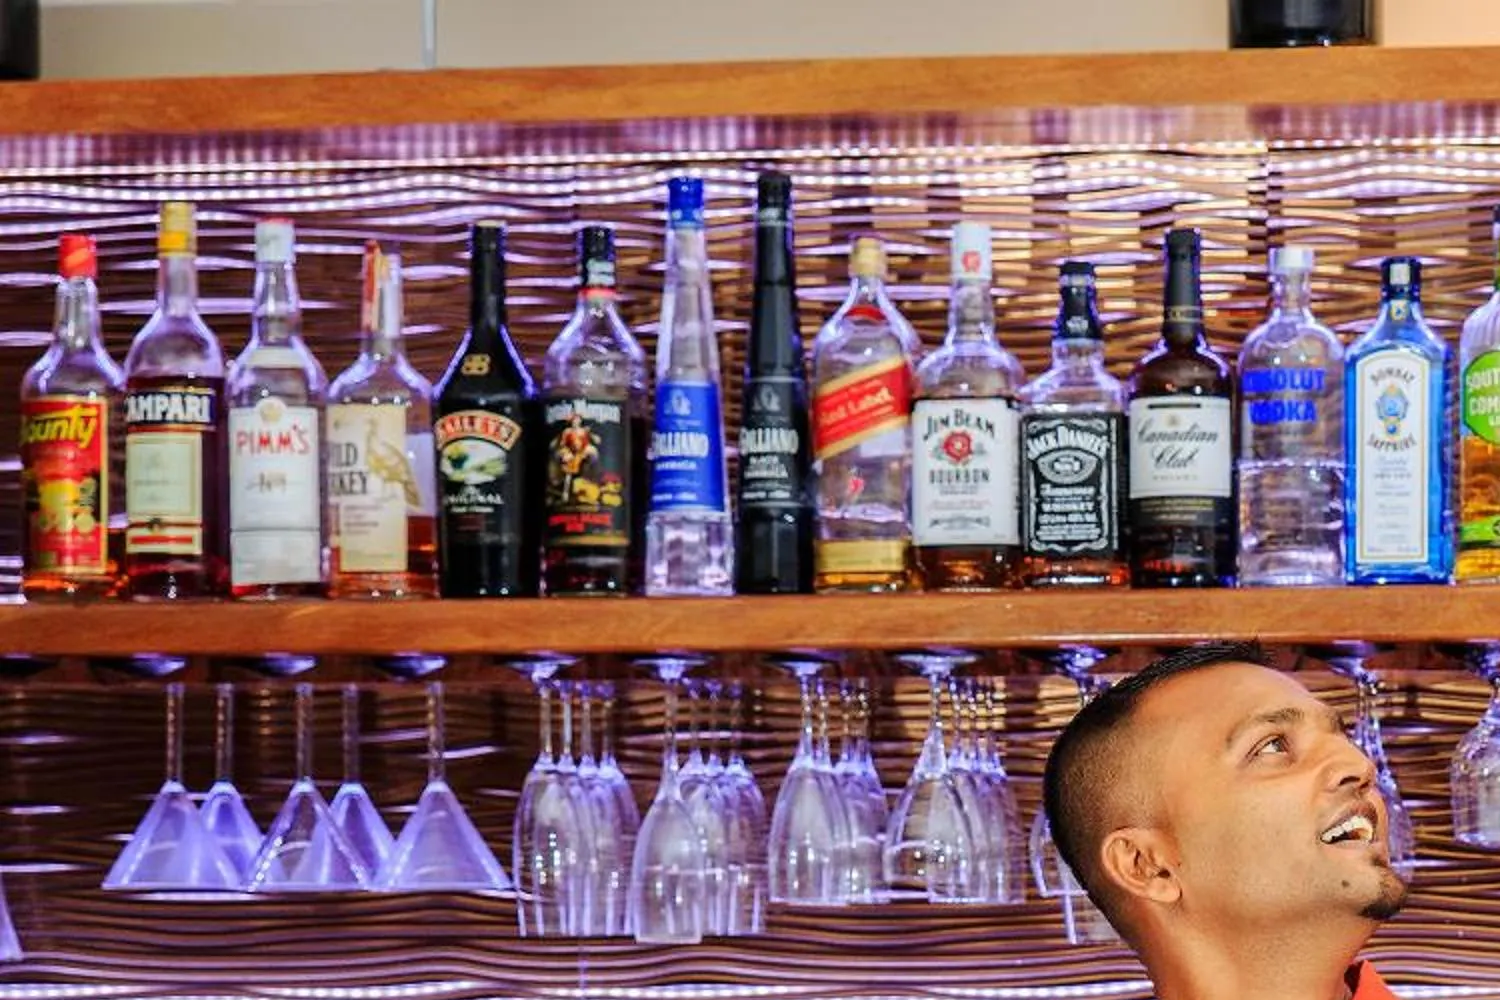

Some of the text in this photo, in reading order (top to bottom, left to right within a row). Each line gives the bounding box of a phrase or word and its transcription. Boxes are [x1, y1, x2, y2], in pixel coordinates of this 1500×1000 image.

[125, 393, 212, 424] AMPARI
[922, 408, 995, 441] JIM BEAM
[22, 404, 98, 449] ounty
[235, 422, 310, 454] PIMM'S
